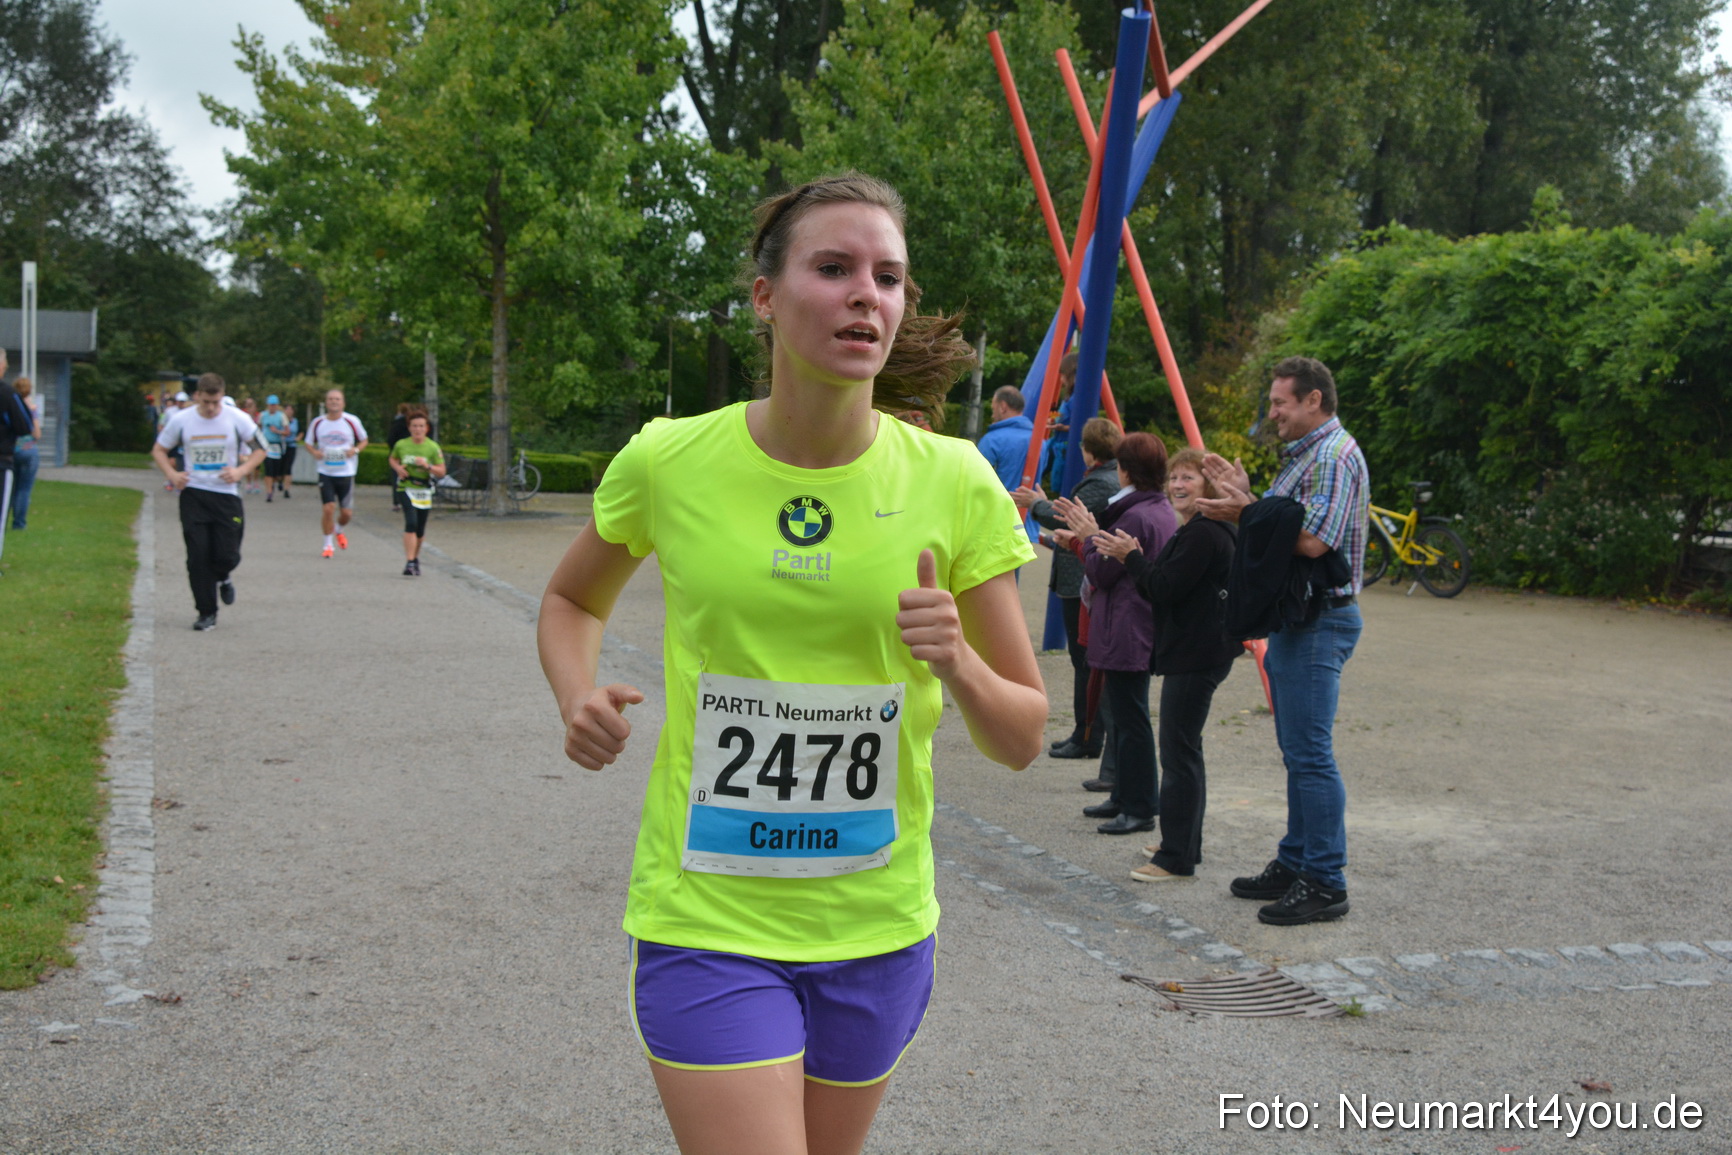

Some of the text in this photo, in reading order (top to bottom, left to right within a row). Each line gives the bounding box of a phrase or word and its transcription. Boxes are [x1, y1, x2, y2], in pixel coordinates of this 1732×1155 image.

[194, 450, 224, 462] 2297
[784, 498, 829, 516] BMW
[772, 549, 831, 571] Partl
[771, 568, 830, 581] Neumarkt
[702, 693, 873, 722] PARTL Neumarkt
[713, 726, 881, 801] 2478
[698, 790, 706, 802] D
[749, 821, 838, 849] Carina
